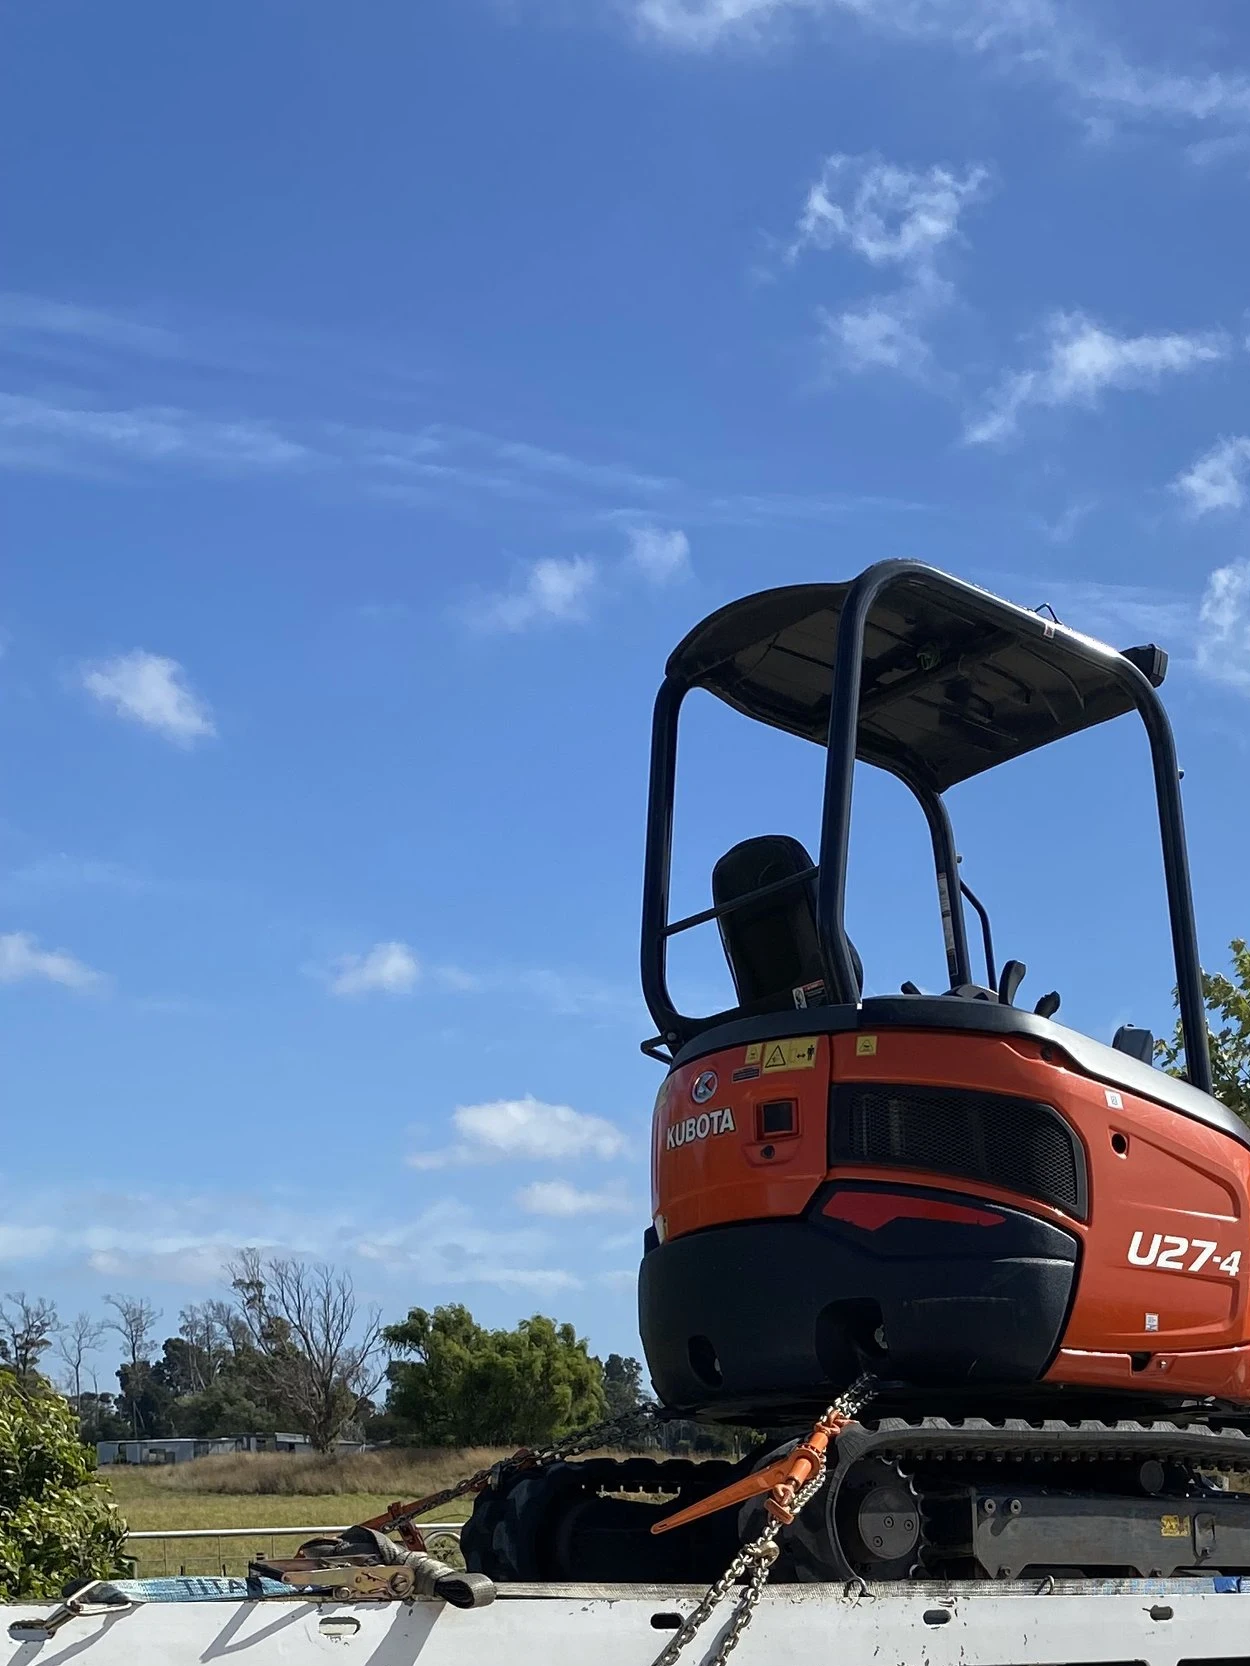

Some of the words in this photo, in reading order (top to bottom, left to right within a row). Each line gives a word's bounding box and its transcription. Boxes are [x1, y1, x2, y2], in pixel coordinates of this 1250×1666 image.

[666, 1108, 735, 1151] KUBOTA
[1127, 1230, 1242, 1277] U27-4
[175, 1578, 251, 1597] TITA
